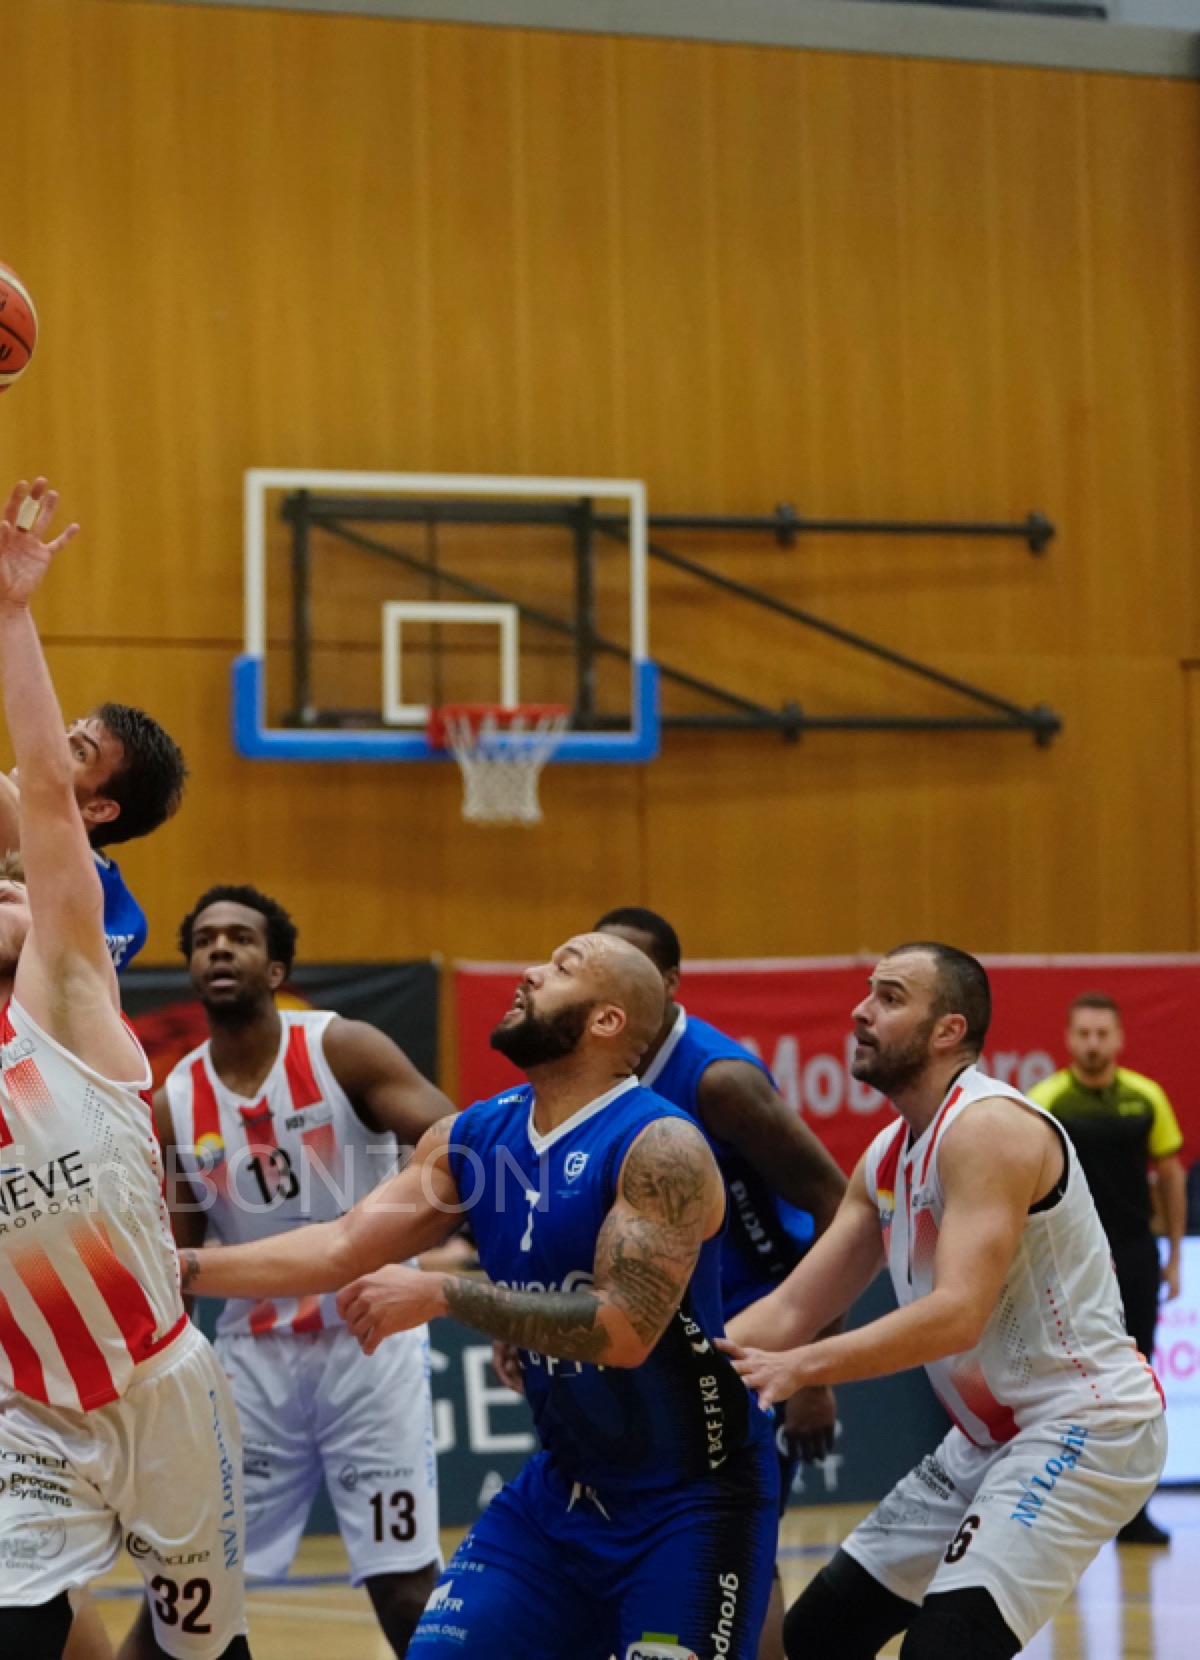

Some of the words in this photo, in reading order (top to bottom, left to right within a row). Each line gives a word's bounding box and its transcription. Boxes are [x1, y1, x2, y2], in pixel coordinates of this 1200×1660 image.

[246, 1147, 300, 1205] 13
[519, 1188, 542, 1252] 7
[369, 1490, 417, 1542] 13
[944, 1514, 981, 1565] 6
[150, 1573, 213, 1635] 32
